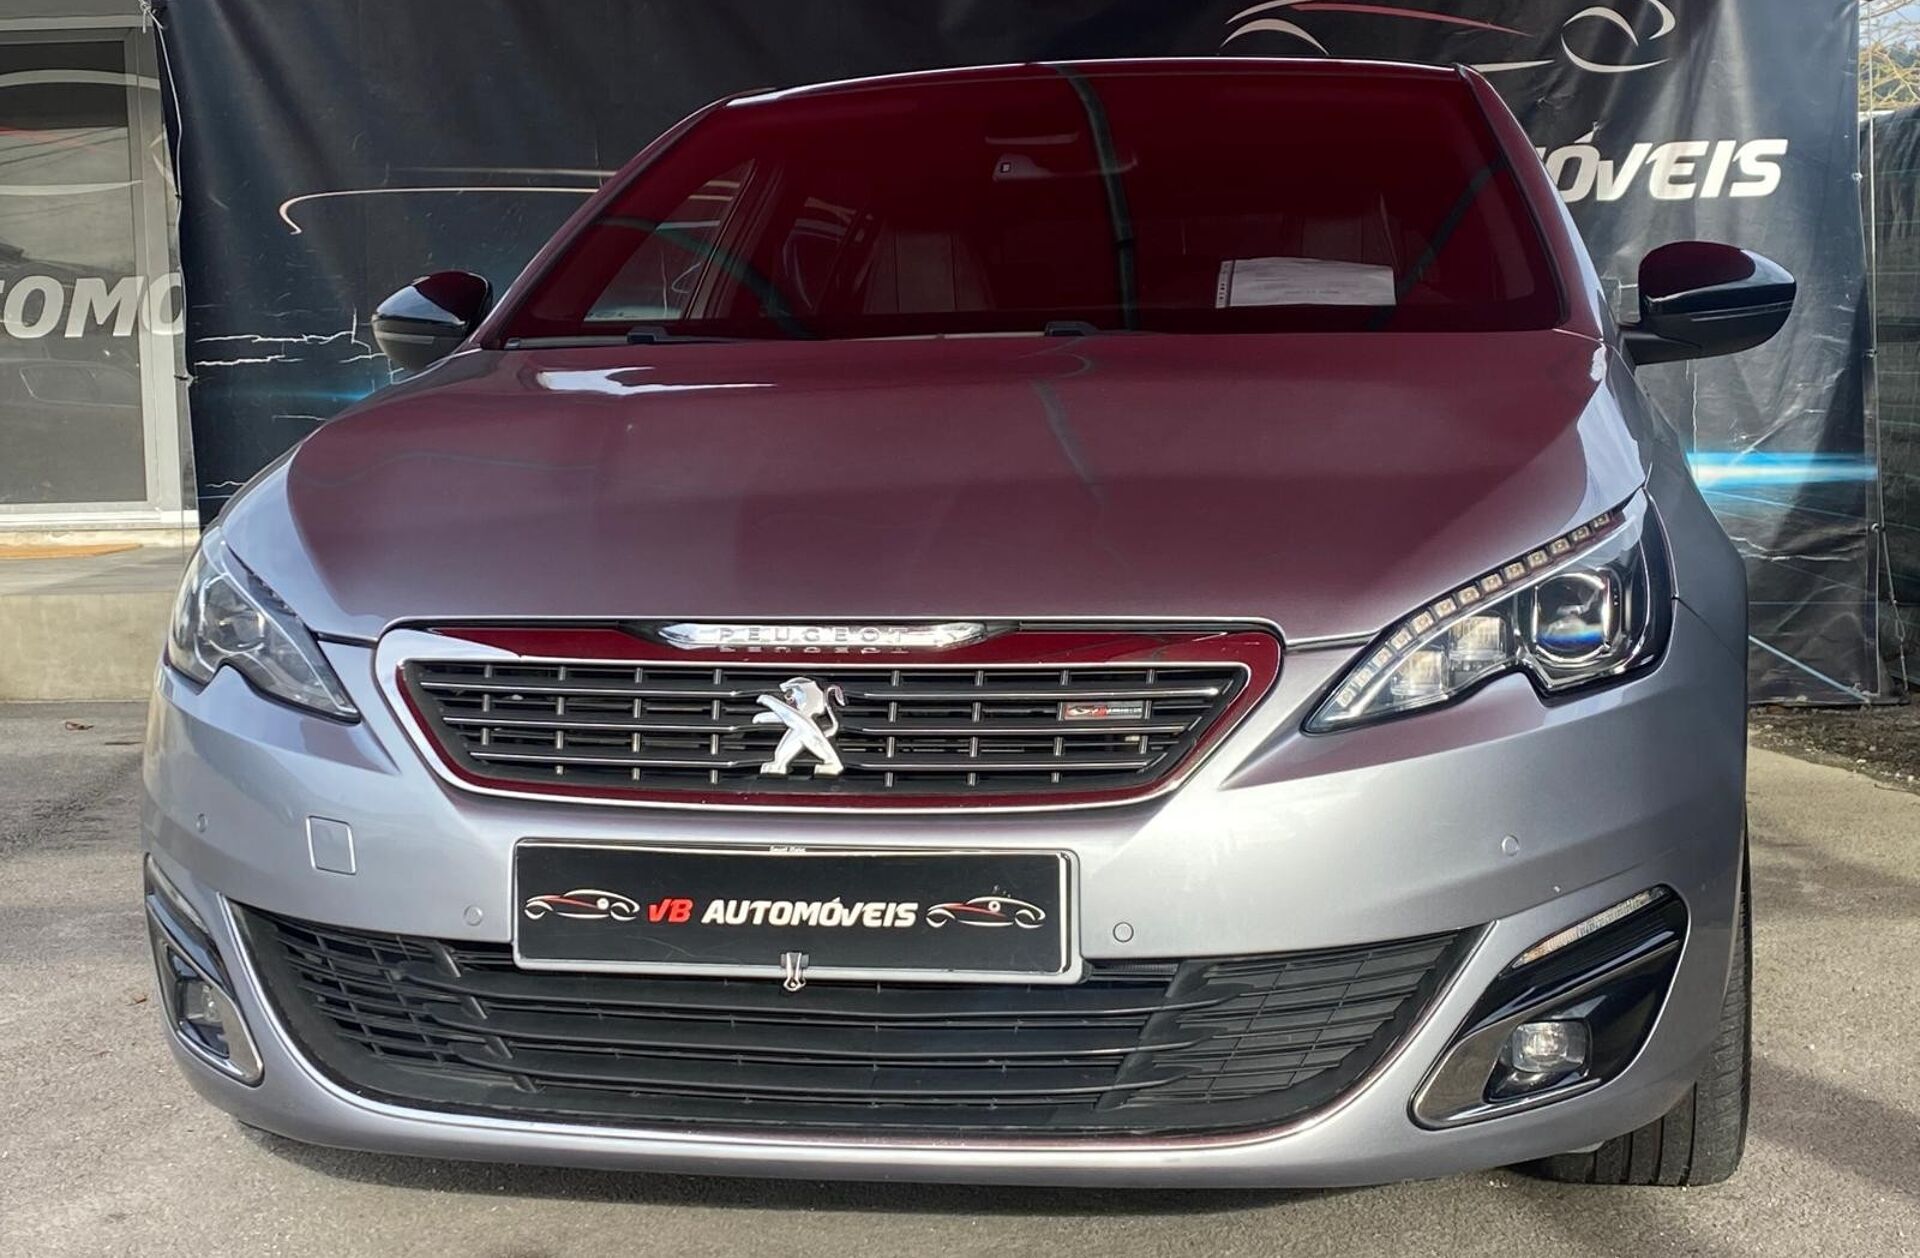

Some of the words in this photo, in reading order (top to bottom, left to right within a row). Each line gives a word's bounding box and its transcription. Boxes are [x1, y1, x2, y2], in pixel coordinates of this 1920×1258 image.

[1534, 121, 1788, 203] ÓVEIS
[0, 272, 184, 340] OMO
[719, 626, 909, 643] PEUGEOT
[648, 898, 694, 923] VB
[701, 896, 919, 928] AUTOMÓVEIS
